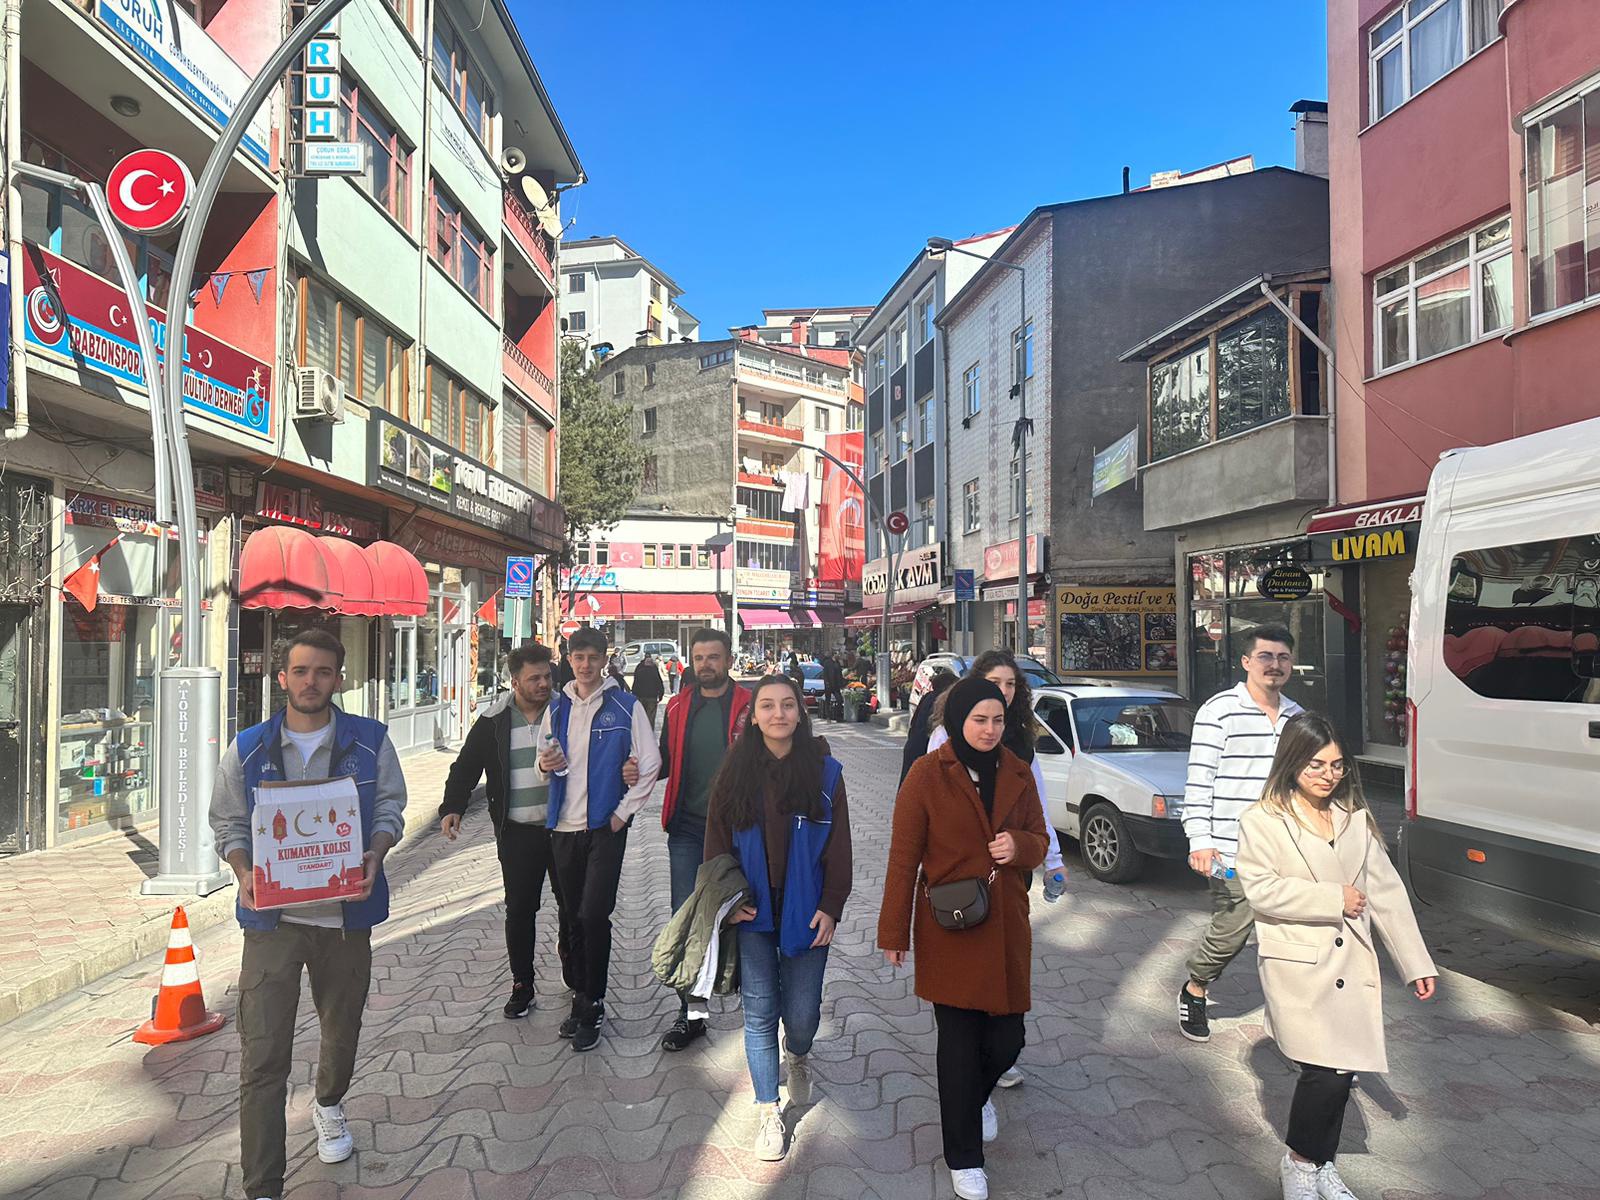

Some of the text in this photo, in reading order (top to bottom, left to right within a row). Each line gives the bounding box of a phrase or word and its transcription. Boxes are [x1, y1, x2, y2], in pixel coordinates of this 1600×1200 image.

[184, 369, 212, 404] KÜLTÜR
[214, 383, 245, 418] DERNEĞİ
[1355, 505, 1424, 527] BAKLA
[907, 562, 934, 588] AVM
[1267, 578, 1309, 588] Pastanesi
[1272, 569, 1301, 578] Livam
[1061, 592, 1099, 609] Doğa
[1103, 590, 1146, 605] Pestil
[1146, 596, 1162, 605] ve
[178, 689, 188, 862] TORUL BELEDİYESİ
[278, 844, 321, 860] KUMANYA
[299, 861, 332, 871] STANDART
